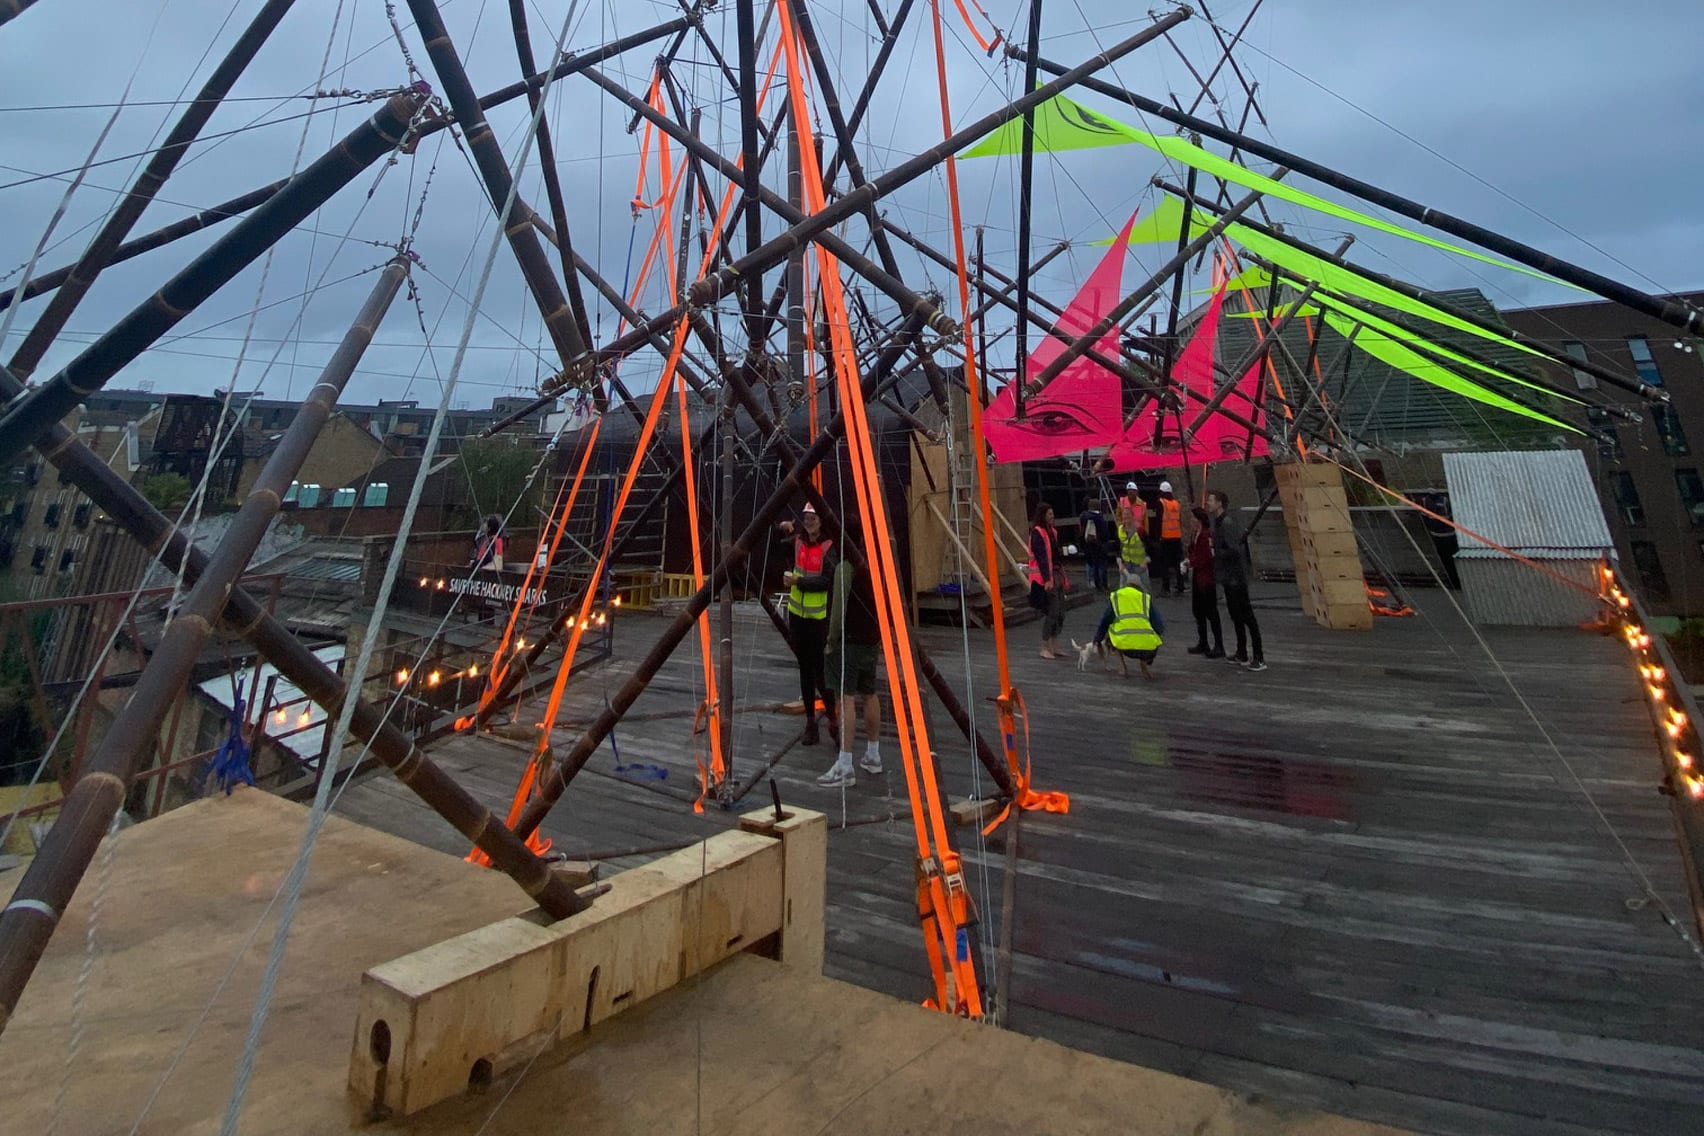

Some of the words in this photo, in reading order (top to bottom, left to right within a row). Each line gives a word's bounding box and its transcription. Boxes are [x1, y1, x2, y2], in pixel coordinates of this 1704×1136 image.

[449, 578, 467, 594] SAVE
[465, 579, 481, 596] THE
[480, 581, 514, 602] HACKNEY
[514, 586, 547, 605] SARKS
